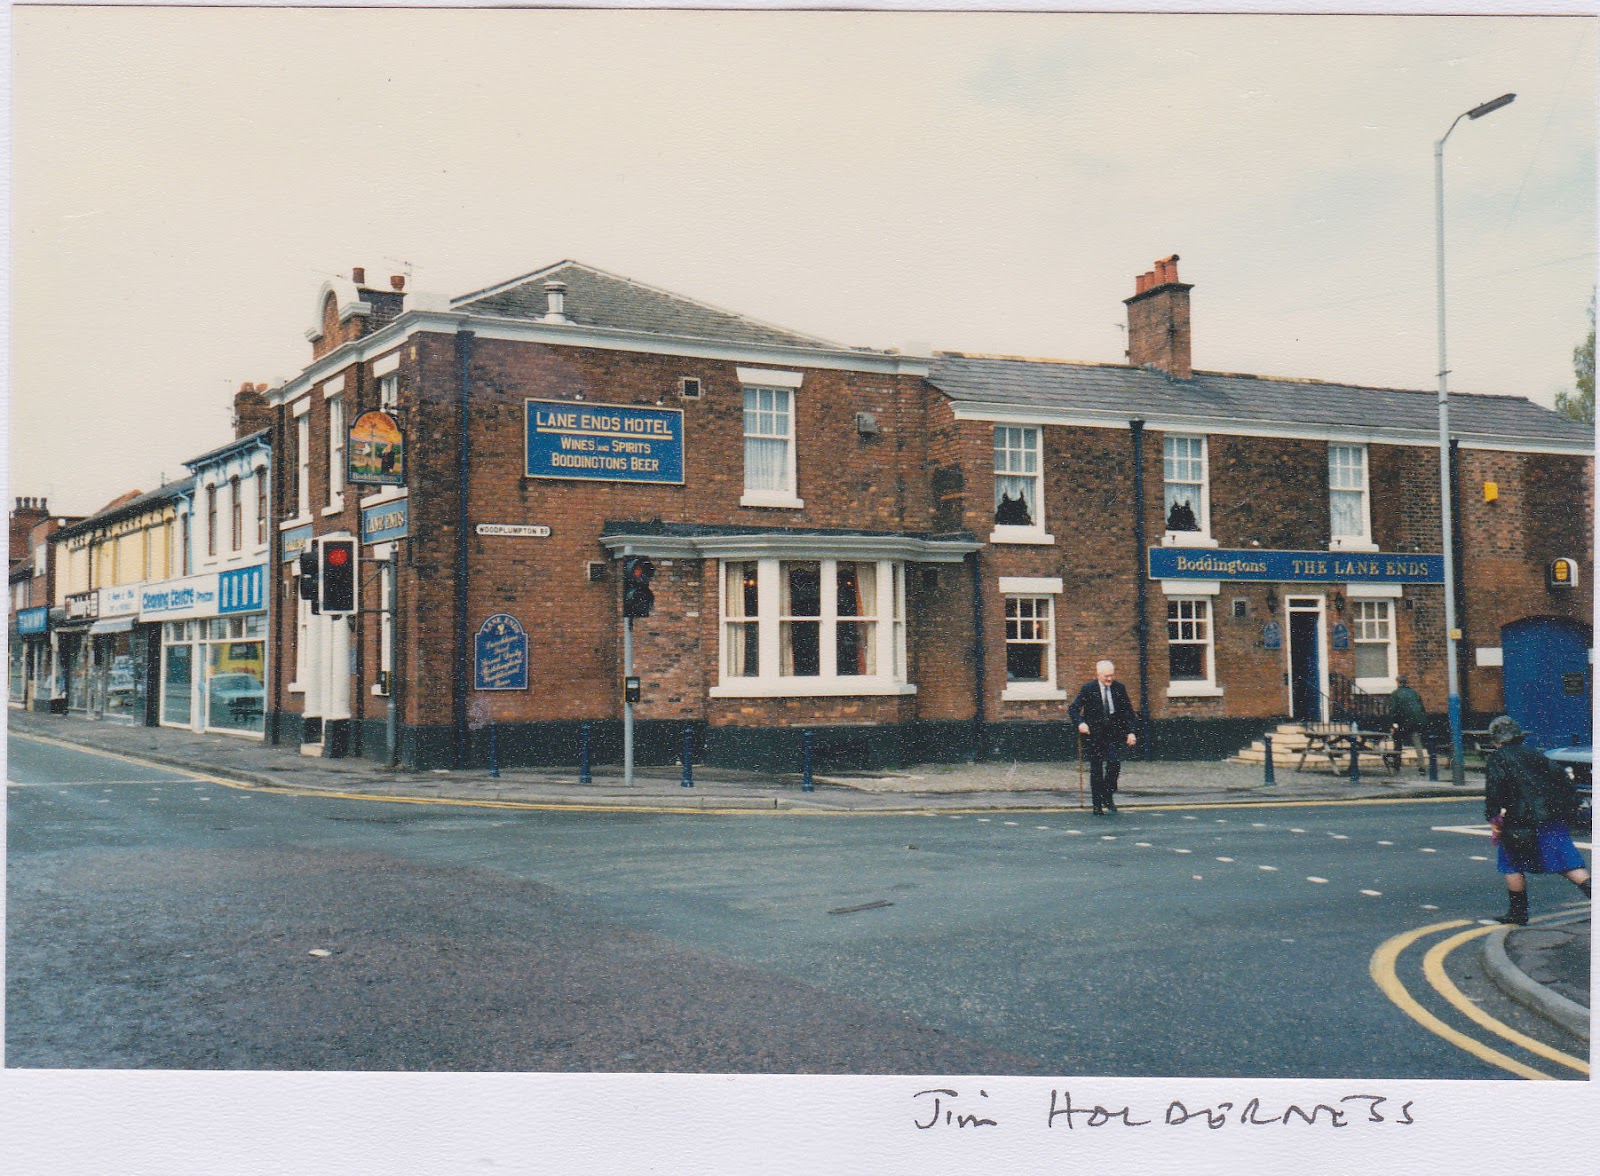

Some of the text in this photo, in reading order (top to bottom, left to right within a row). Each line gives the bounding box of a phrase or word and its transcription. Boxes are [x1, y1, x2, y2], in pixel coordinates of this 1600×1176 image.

[536, 411, 673, 435] LANE ENDS HOTEL
[551, 452, 659, 471] BODDINGTONS BEER
[480, 526, 537, 534] WOODPLUMPTON
[1176, 556, 1430, 577] Boddingtons THE LANE ENDS
